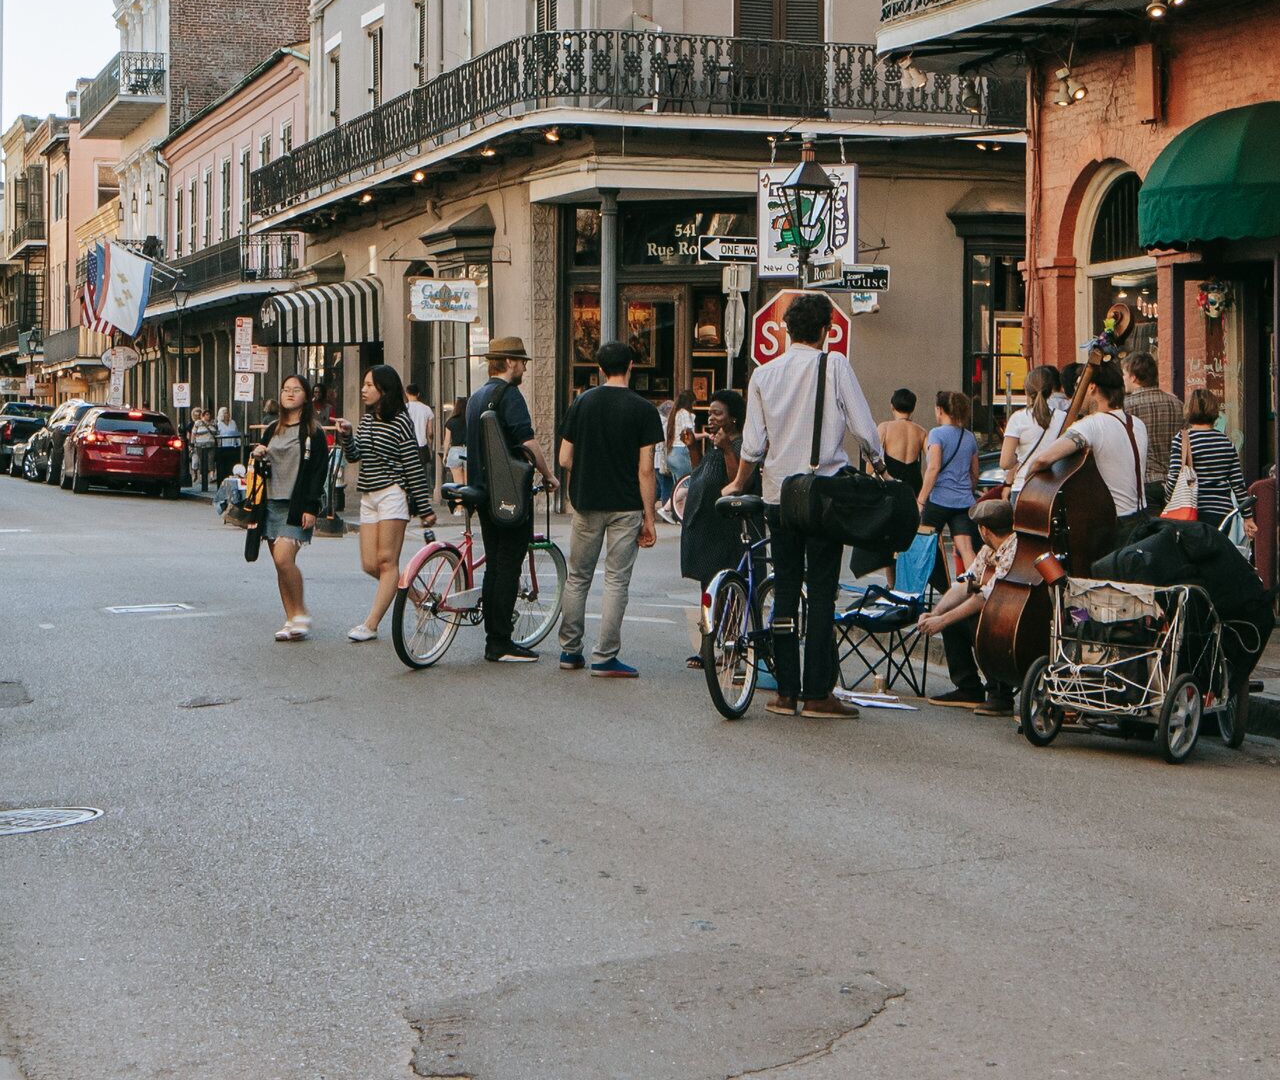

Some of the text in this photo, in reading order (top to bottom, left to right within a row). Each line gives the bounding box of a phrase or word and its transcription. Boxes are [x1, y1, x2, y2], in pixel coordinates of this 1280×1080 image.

[674, 223, 697, 237] 541
[646, 242, 674, 256] Rue
[721, 245, 757, 256] ONE WA
[763, 264, 783, 272] New
[813, 265, 835, 281] Royal
